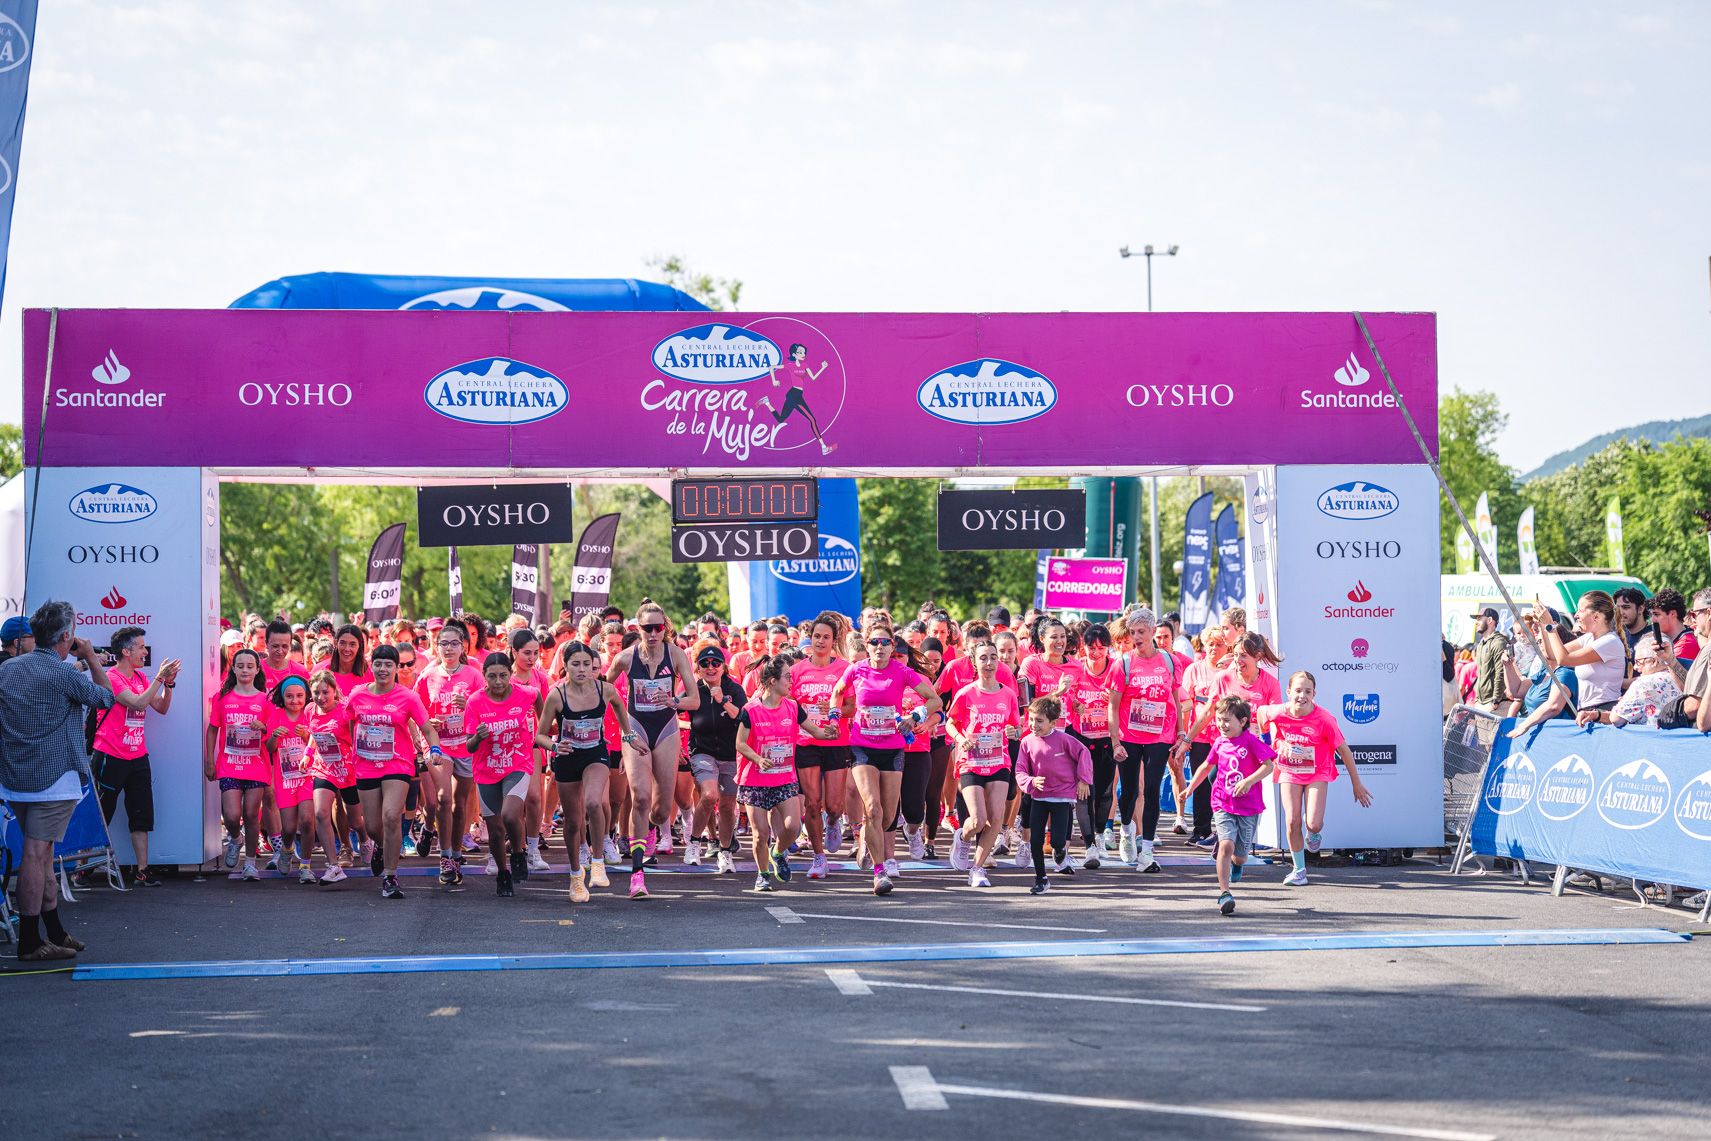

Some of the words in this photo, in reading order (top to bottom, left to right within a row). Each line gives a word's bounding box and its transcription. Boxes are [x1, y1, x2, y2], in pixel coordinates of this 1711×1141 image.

[662, 345, 771, 369] ASTURIANA
[55, 388, 167, 407] Santander
[238, 382, 352, 407] OYSHO
[436, 381, 558, 408] ASTURIANA
[640, 379, 748, 411] Carrera
[928, 383, 1047, 408] ASTURIANA
[1126, 384, 1234, 407] OYSHO
[666, 412, 687, 435] de
[691, 412, 706, 435] la
[702, 409, 788, 461] Mujer
[75, 497, 151, 514] ASTURIANA
[1323, 495, 1393, 511] ASTURIANA
[443, 502, 550, 528] OYSHO
[961, 508, 1066, 531] OYSHO
[581, 544, 611, 554] OYSHO
[678, 528, 812, 558] OYSHO
[1317, 540, 1401, 559] OYSHO
[67, 544, 159, 564] OYSHO
[372, 558, 401, 568] OYSHO
[776, 559, 856, 573] ASTURIANA
[1092, 566, 1123, 575] OYSHO
[1047, 581, 1122, 595] CORREDORAS
[76, 613, 152, 625] Santander
[1324, 606, 1395, 618] Santander
[1322, 662, 1364, 673] octopus
[1365, 662, 1399, 673] energy
[801, 683, 833, 694] CARRERA
[1132, 676, 1164, 686] CARRERA
[1345, 700, 1378, 717] Marlene
[226, 713, 258, 723] CARRERA
[367, 740, 382, 748] 016
[486, 756, 513, 768] MUJER
[1334, 750, 1393, 763] trogena
[1487, 774, 1531, 800] ASTURIANA
[1541, 777, 1587, 804] ASTURIANA
[1600, 781, 1663, 815] ASTURIANA
